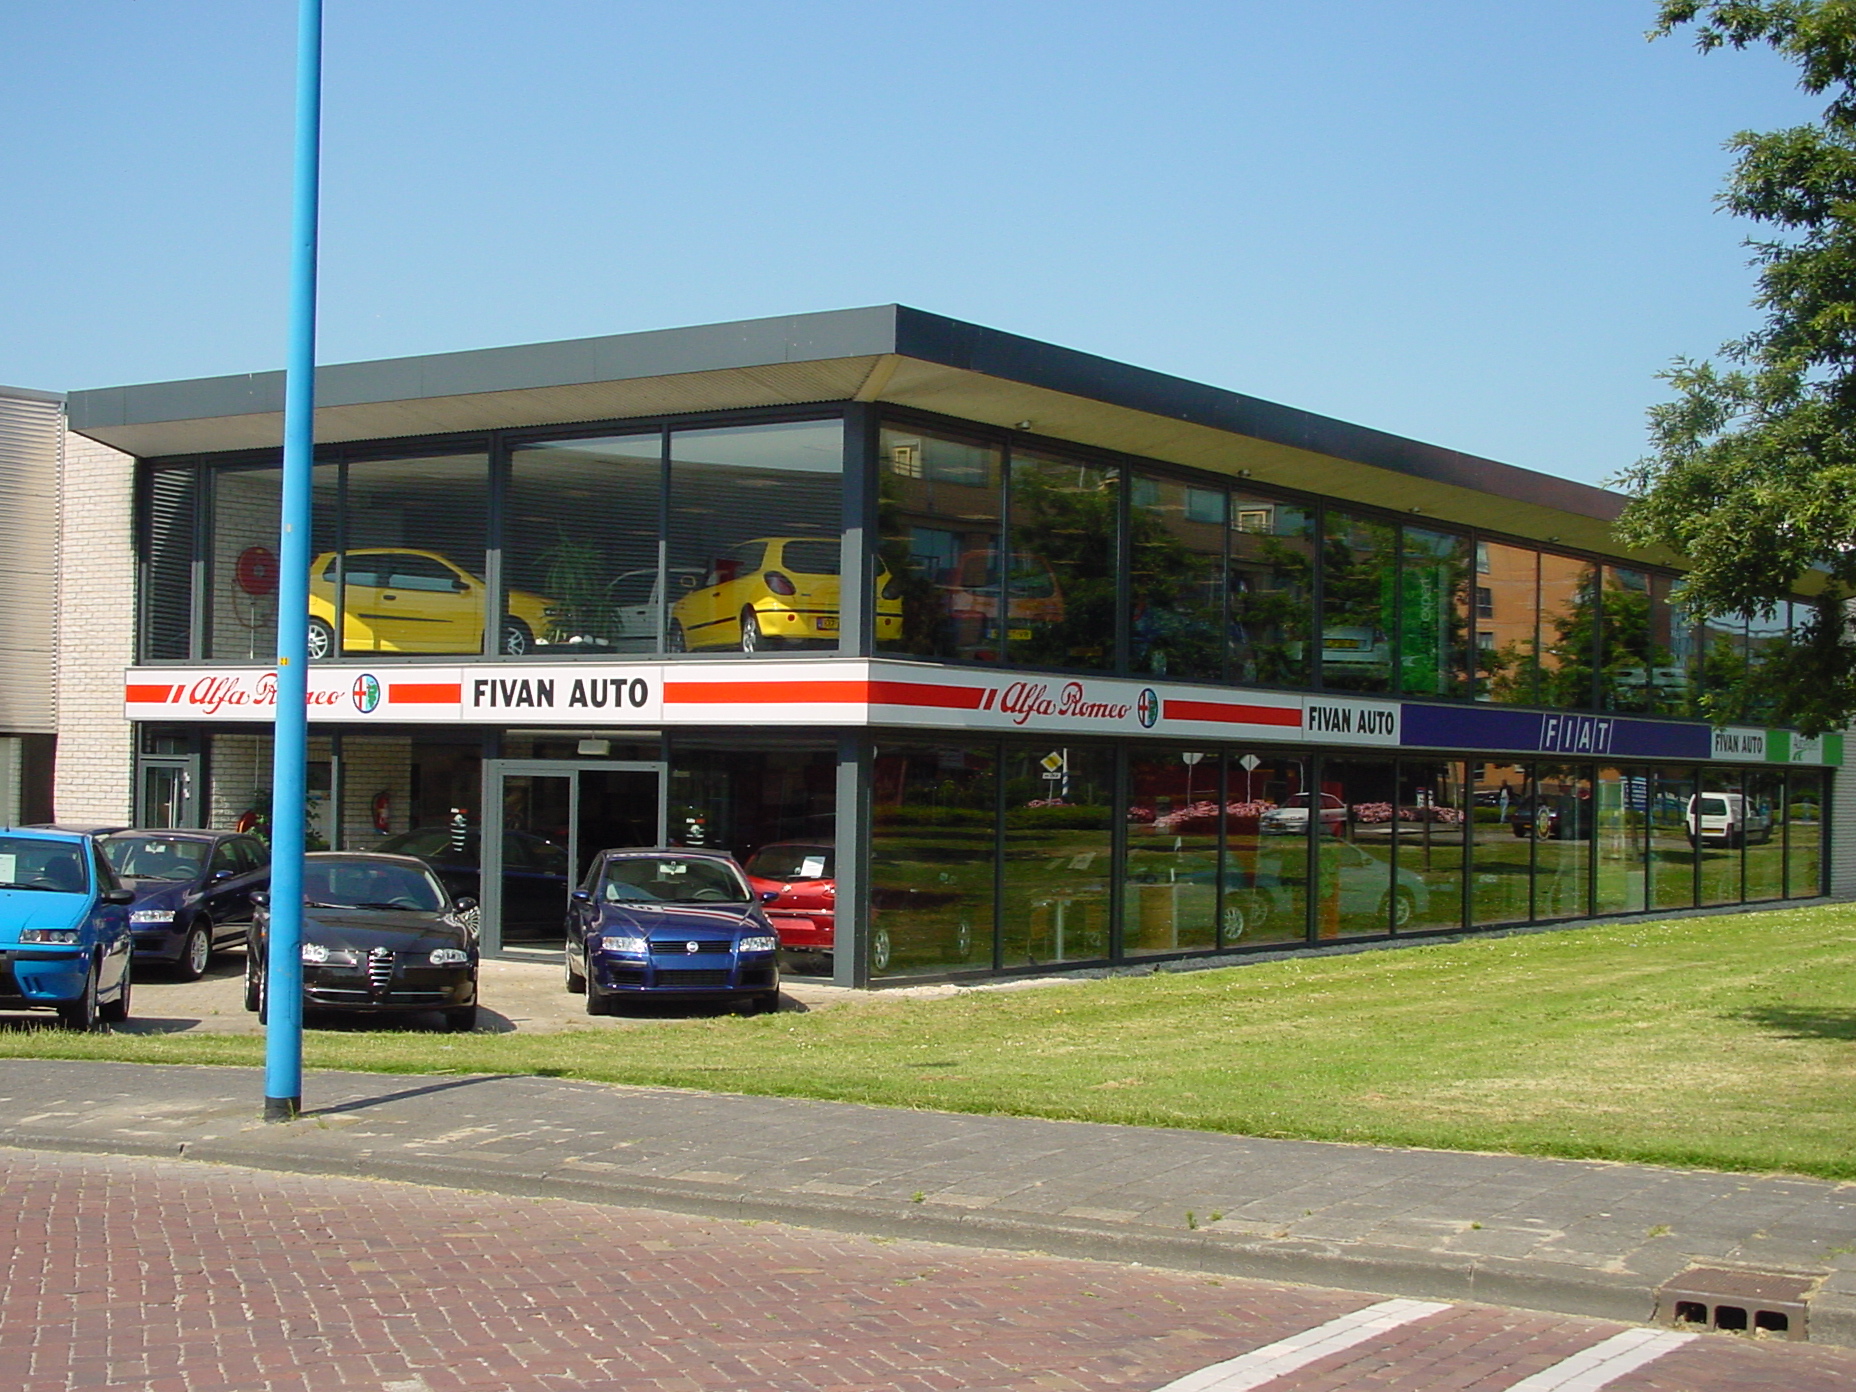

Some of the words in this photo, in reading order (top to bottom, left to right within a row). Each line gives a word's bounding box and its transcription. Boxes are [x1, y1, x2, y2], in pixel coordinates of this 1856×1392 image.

[189, 676, 250, 714] Alfa
[252, 672, 345, 706] Reo
[474, 678, 554, 708] FIVAN
[568, 677, 648, 708] AUTO
[1000, 682, 1057, 725] Alfa
[1057, 682, 1132, 721] Romeo
[1309, 706, 1351, 734] FIVAN
[1358, 709, 1395, 736] AUTO
[1545, 719, 1609, 750] FIAT
[1715, 733, 1740, 753] FIVAN
[1742, 735, 1763, 755] AUTO
